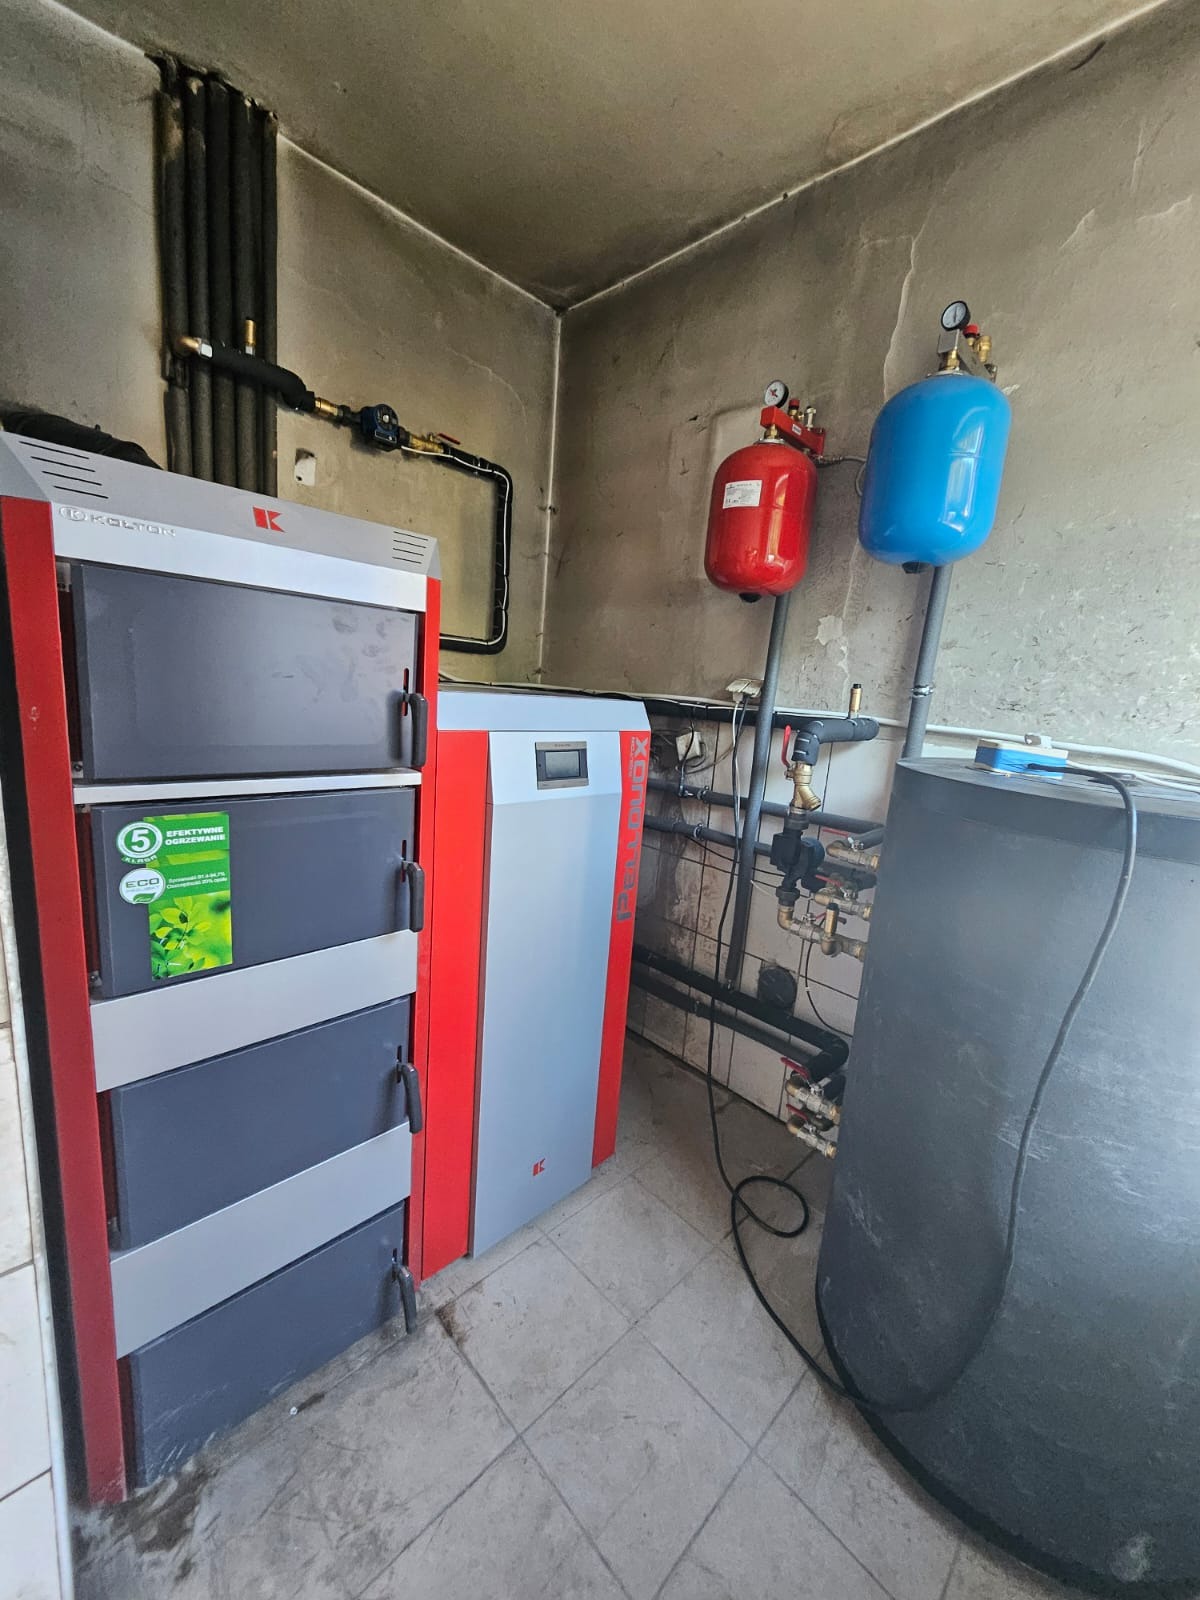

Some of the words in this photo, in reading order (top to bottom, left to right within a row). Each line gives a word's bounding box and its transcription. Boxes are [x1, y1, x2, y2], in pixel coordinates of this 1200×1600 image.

[166, 826, 224, 838] EFEKTYWNE
[131, 829, 151, 852] 5
[165, 834, 226, 846] OGRZEWANIE
[126, 877, 160, 888] ECO
